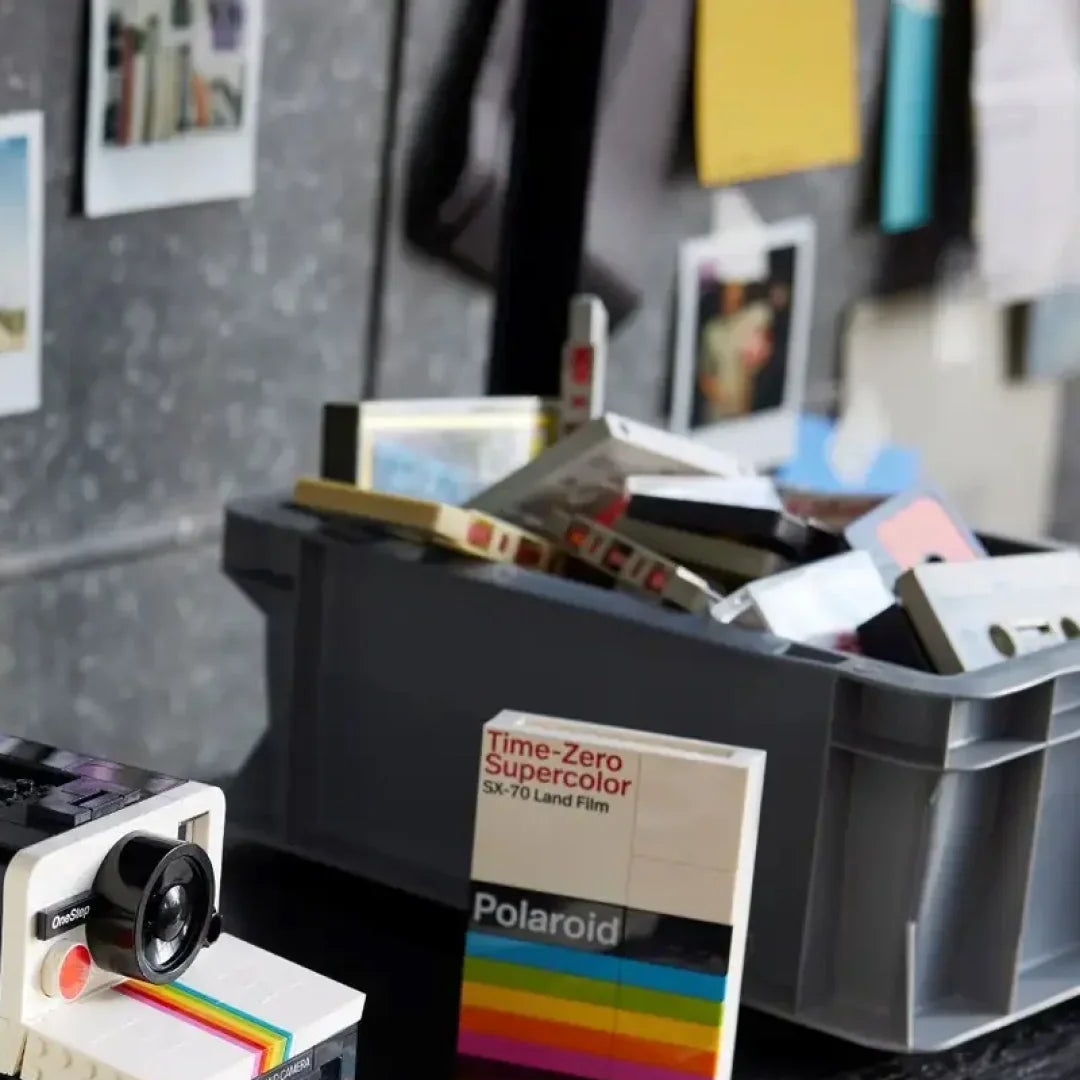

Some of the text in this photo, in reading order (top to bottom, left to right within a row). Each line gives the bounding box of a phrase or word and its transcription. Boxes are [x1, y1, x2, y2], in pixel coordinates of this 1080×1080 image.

[486, 729, 623, 773] Time-Zero
[484, 752, 633, 797] Supercolor
[482, 779, 610, 814] SX-70 Land Film
[51, 904, 90, 930] OneStep
[472, 891, 620, 947] Polaroid
[279, 1056, 311, 1080] CAMERA
